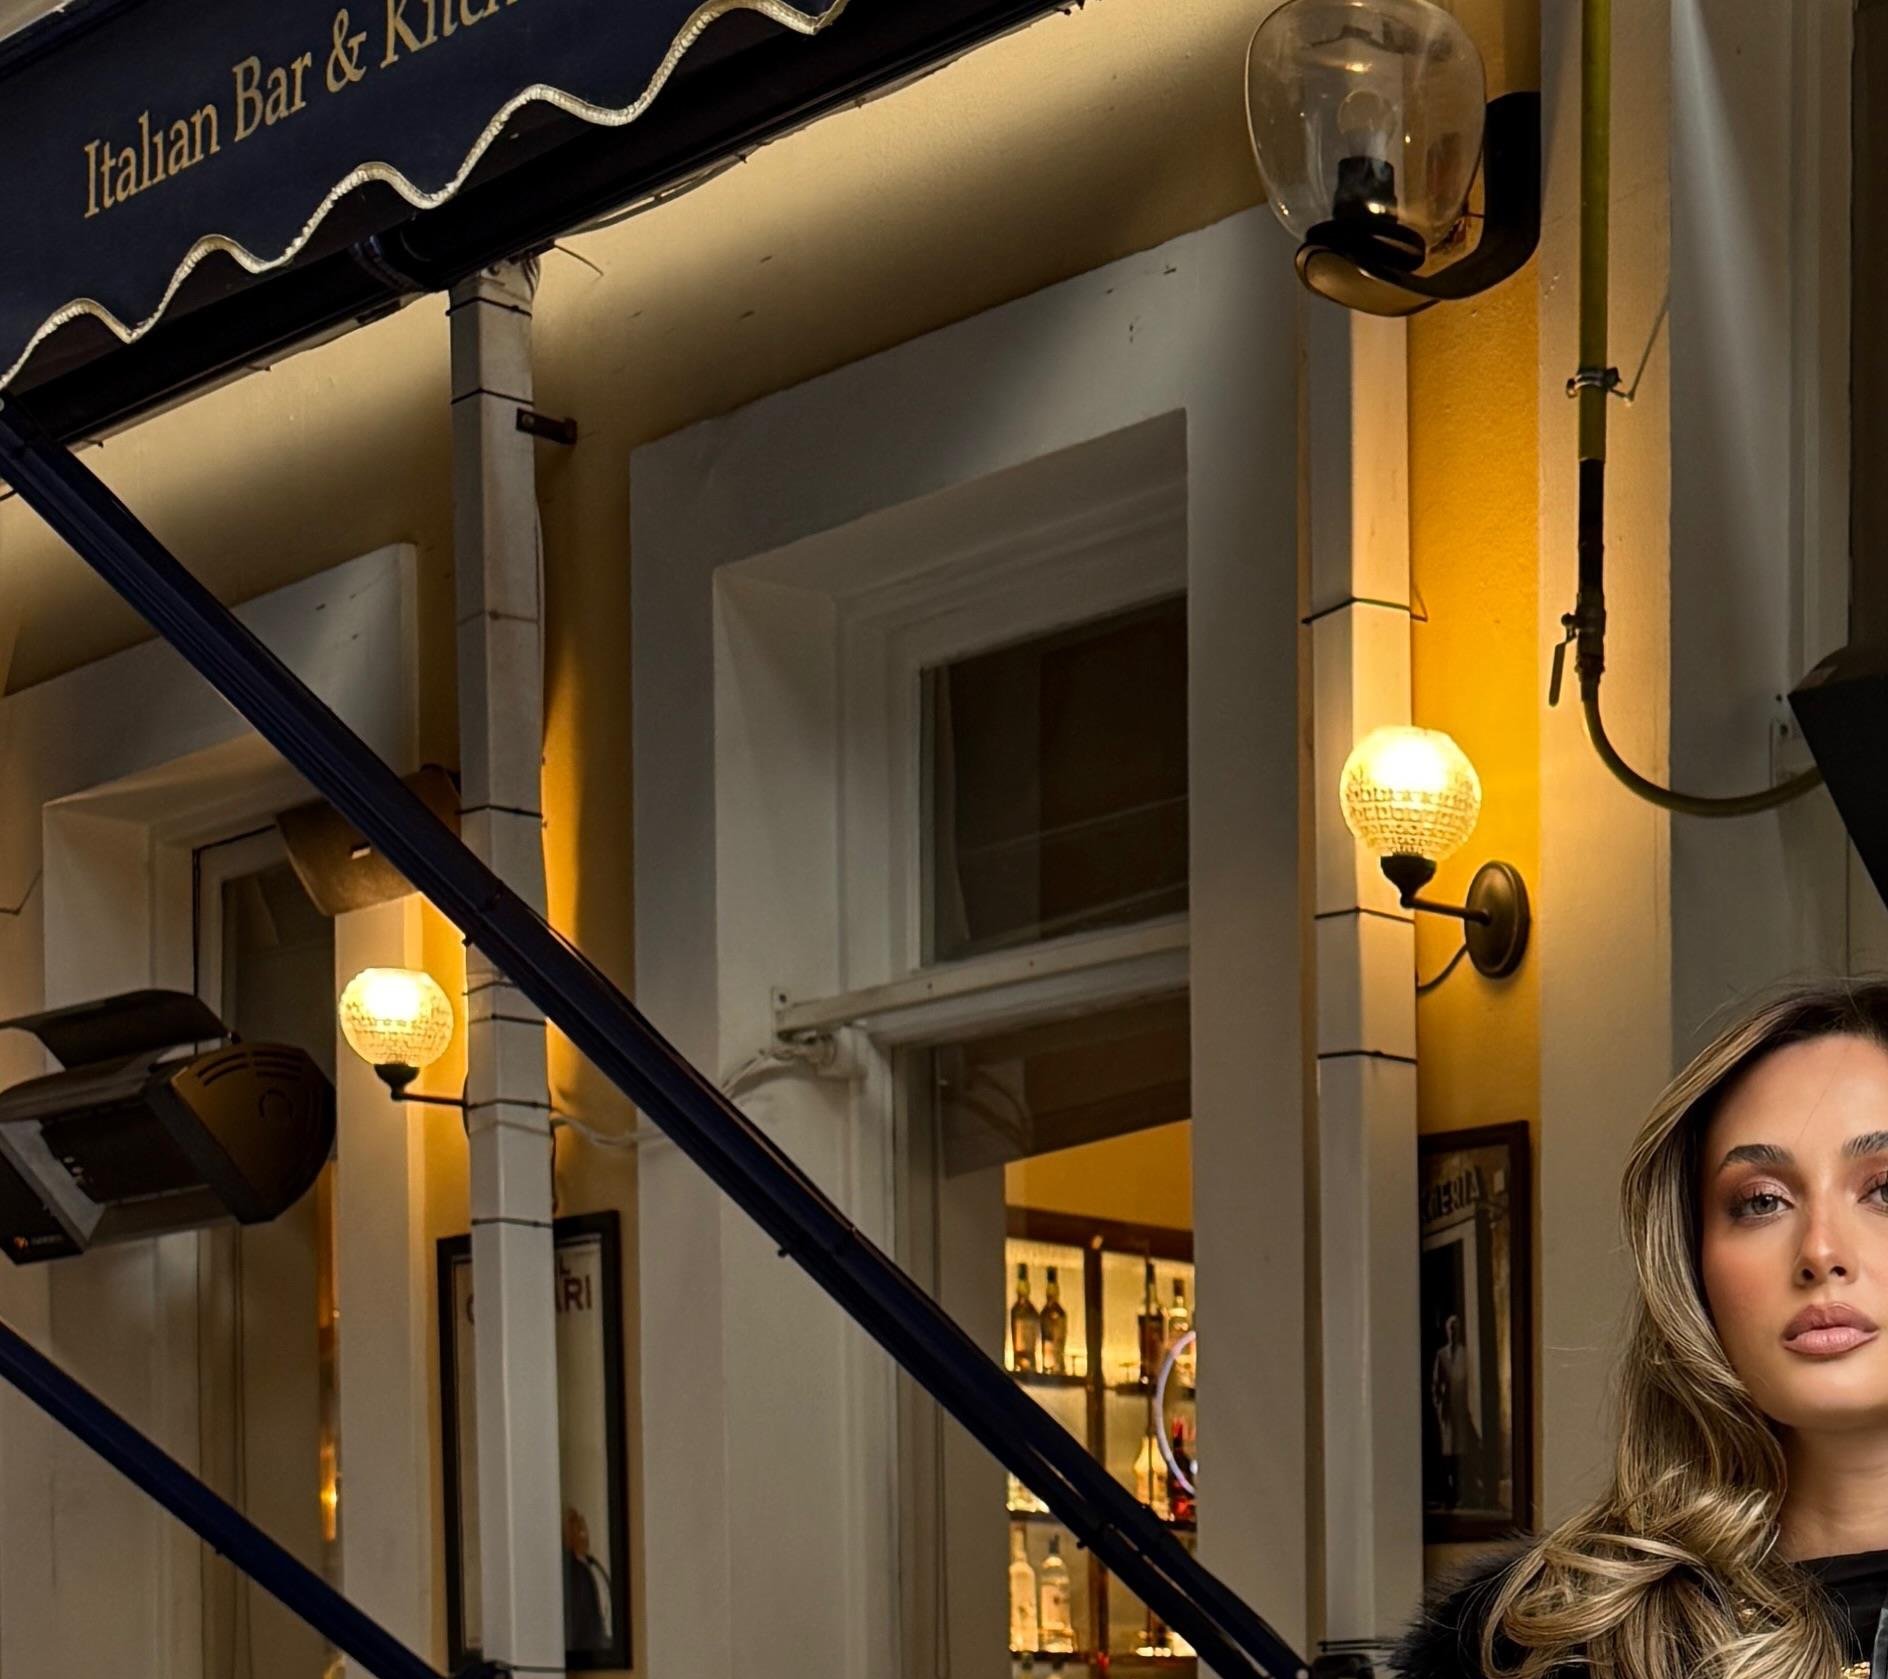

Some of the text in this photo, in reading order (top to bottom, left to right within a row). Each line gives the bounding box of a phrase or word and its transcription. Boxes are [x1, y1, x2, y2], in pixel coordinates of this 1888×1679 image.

[83, 103, 221, 218] Italian
[231, 51, 312, 142] Bar
[326, 8, 367, 93] &
